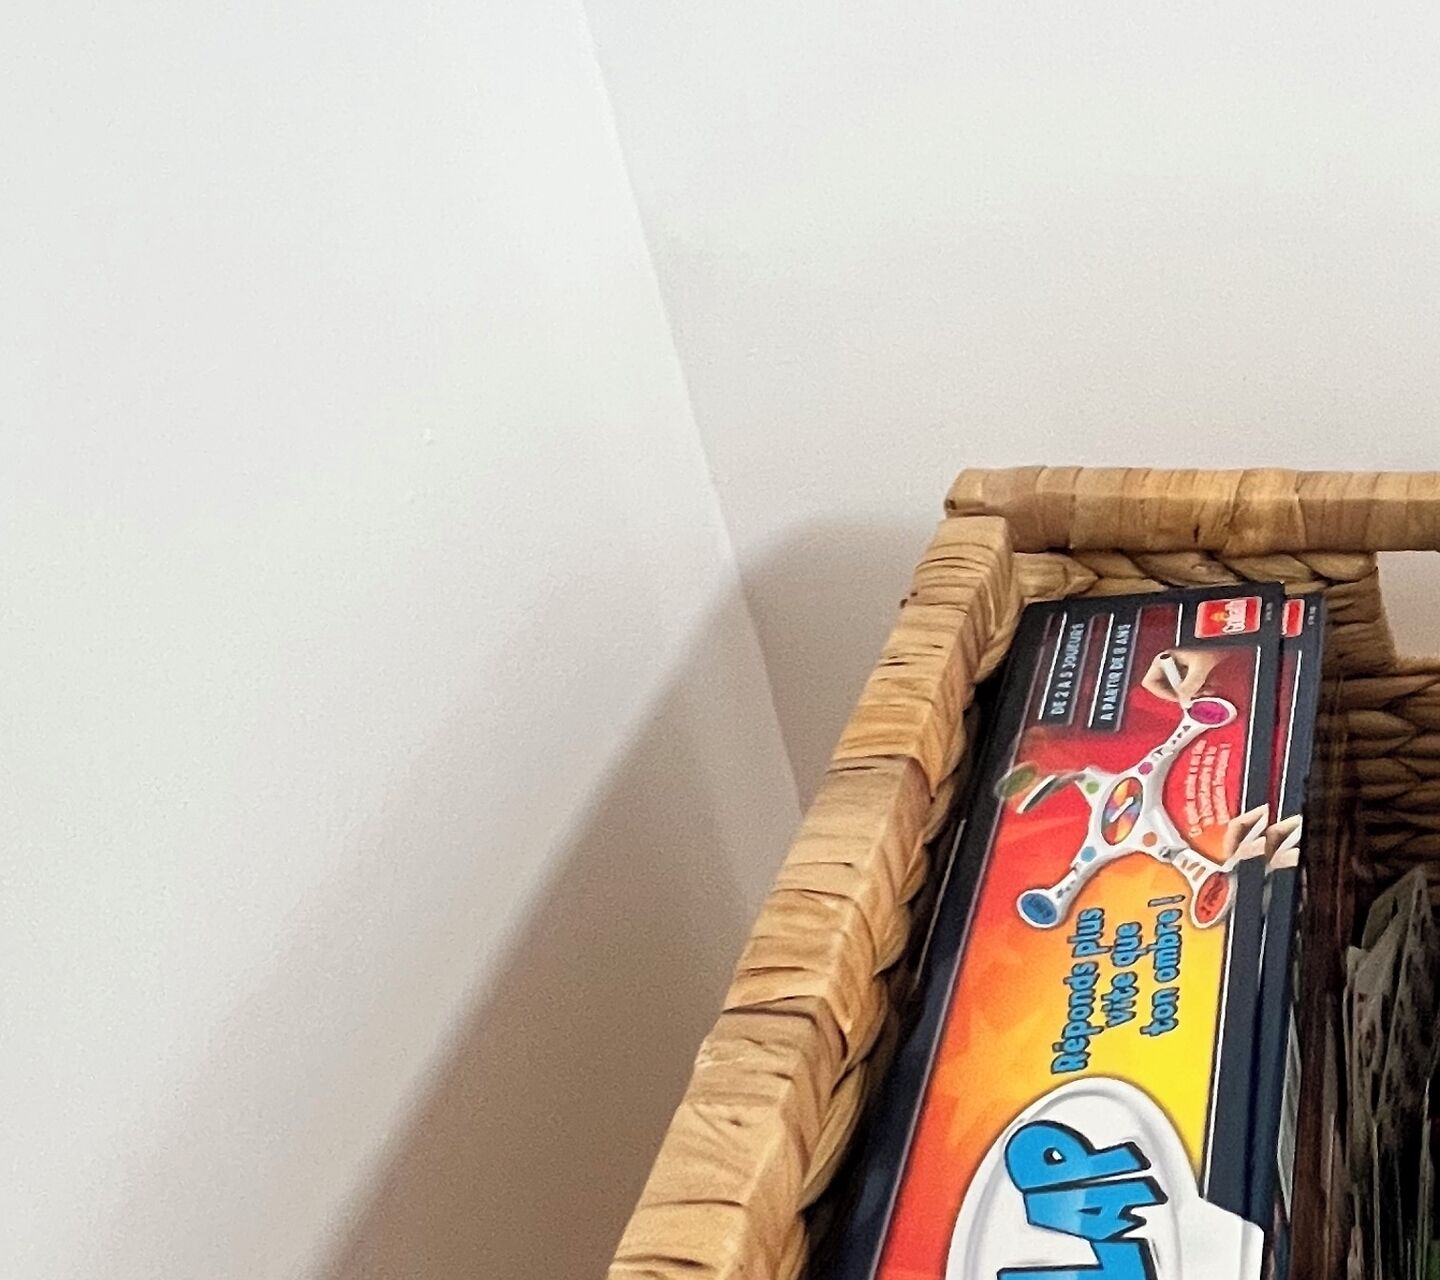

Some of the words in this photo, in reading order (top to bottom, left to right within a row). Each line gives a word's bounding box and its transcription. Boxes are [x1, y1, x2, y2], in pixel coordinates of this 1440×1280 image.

[1061, 623, 1085, 669] JOUEURS
[1115, 624, 1132, 645] ANS
[1109, 655, 1125, 670] DE
[1102, 671, 1123, 711] PARTIR
[1067, 907, 1113, 958] plus
[1110, 921, 1151, 967] que
[1145, 908, 1183, 983] ombre
[1050, 961, 1105, 1074] Réponds
[1100, 970, 1139, 1028] vite
[1139, 986, 1180, 1037] ton
